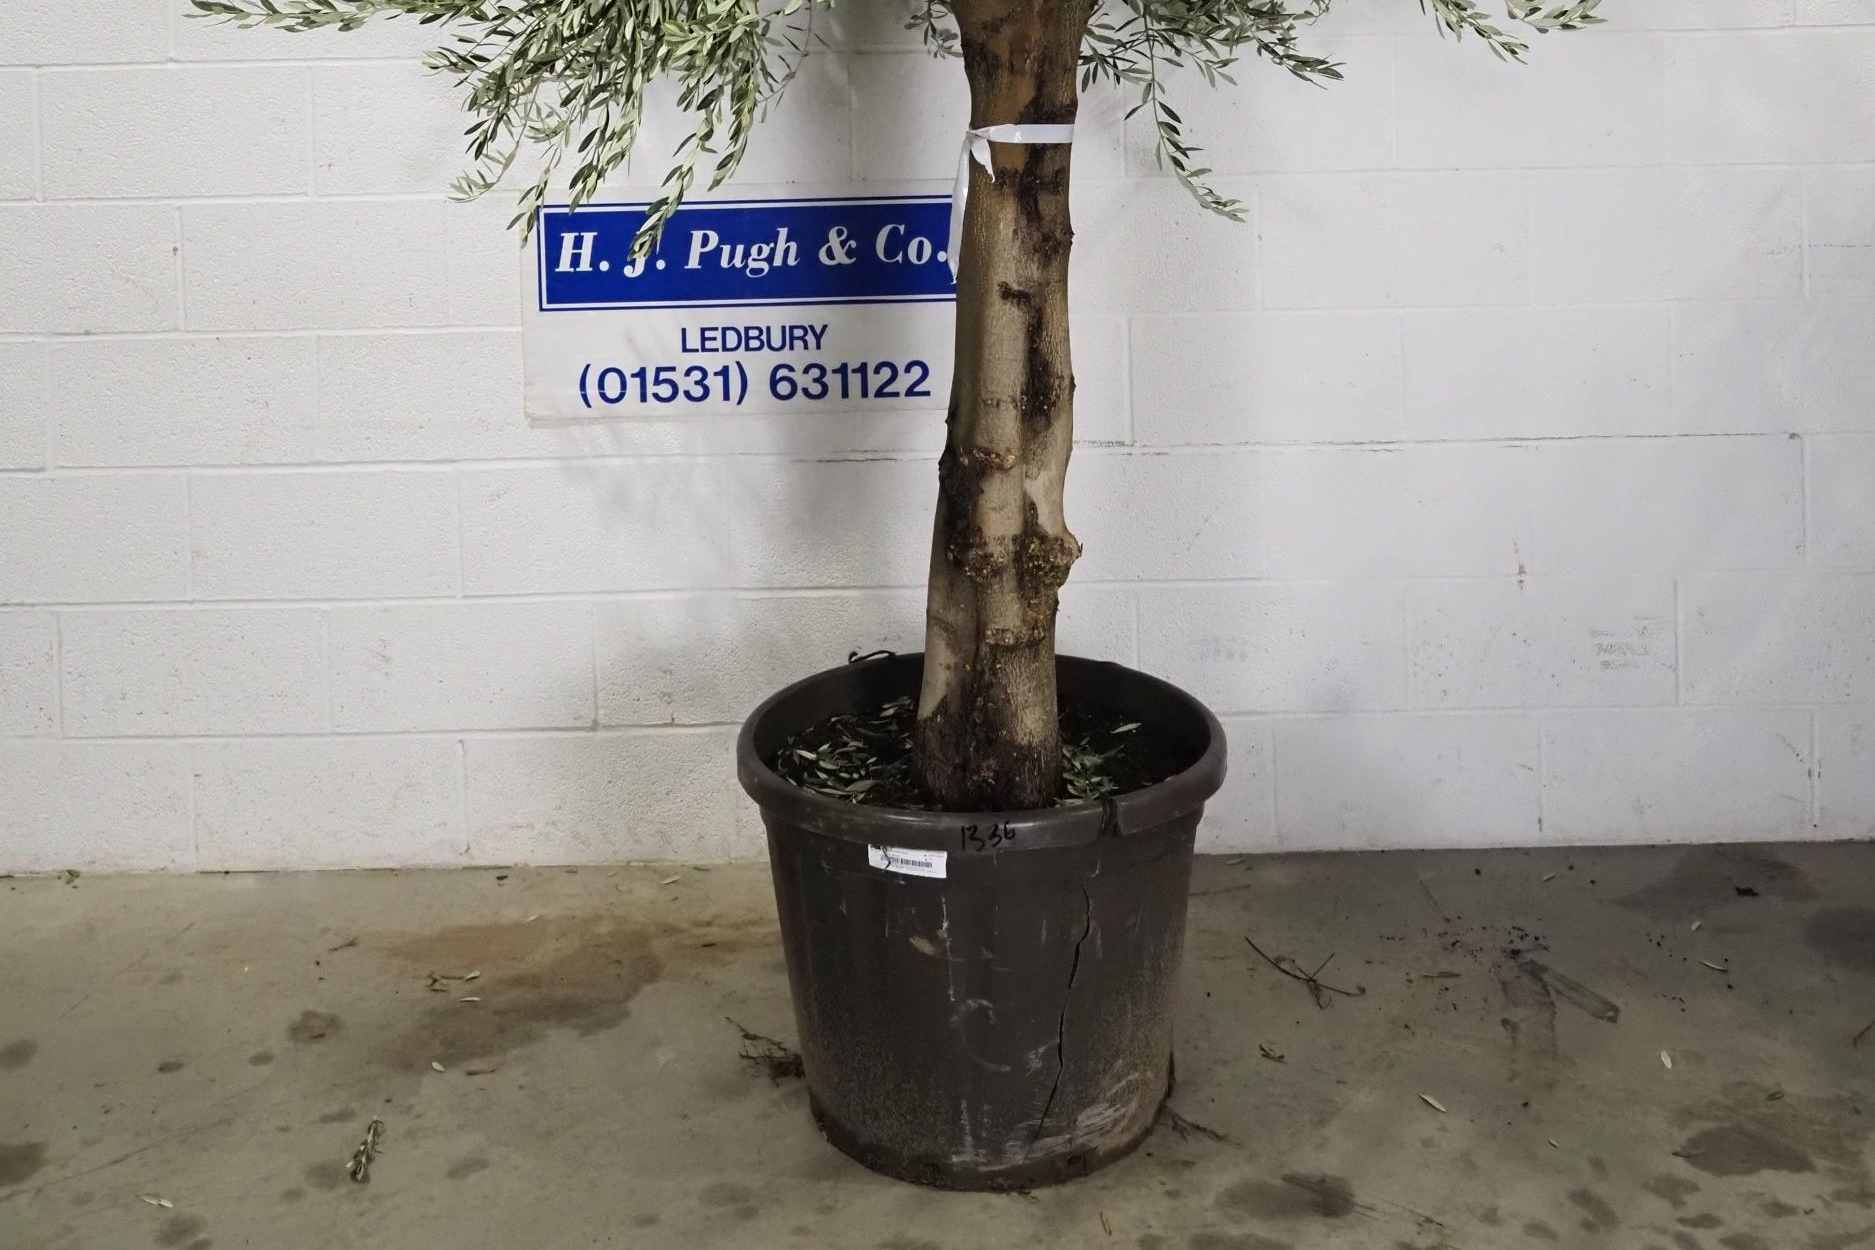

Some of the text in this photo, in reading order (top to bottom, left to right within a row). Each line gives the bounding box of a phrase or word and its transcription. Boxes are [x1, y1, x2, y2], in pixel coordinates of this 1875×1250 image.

[554, 232, 610, 273] H.
[684, 227, 799, 278] Pugh
[817, 225, 857, 266] &
[875, 224, 948, 265] Co.
[680, 324, 829, 354] LEDBURY
[578, 359, 931, 409] (01531) 631122
